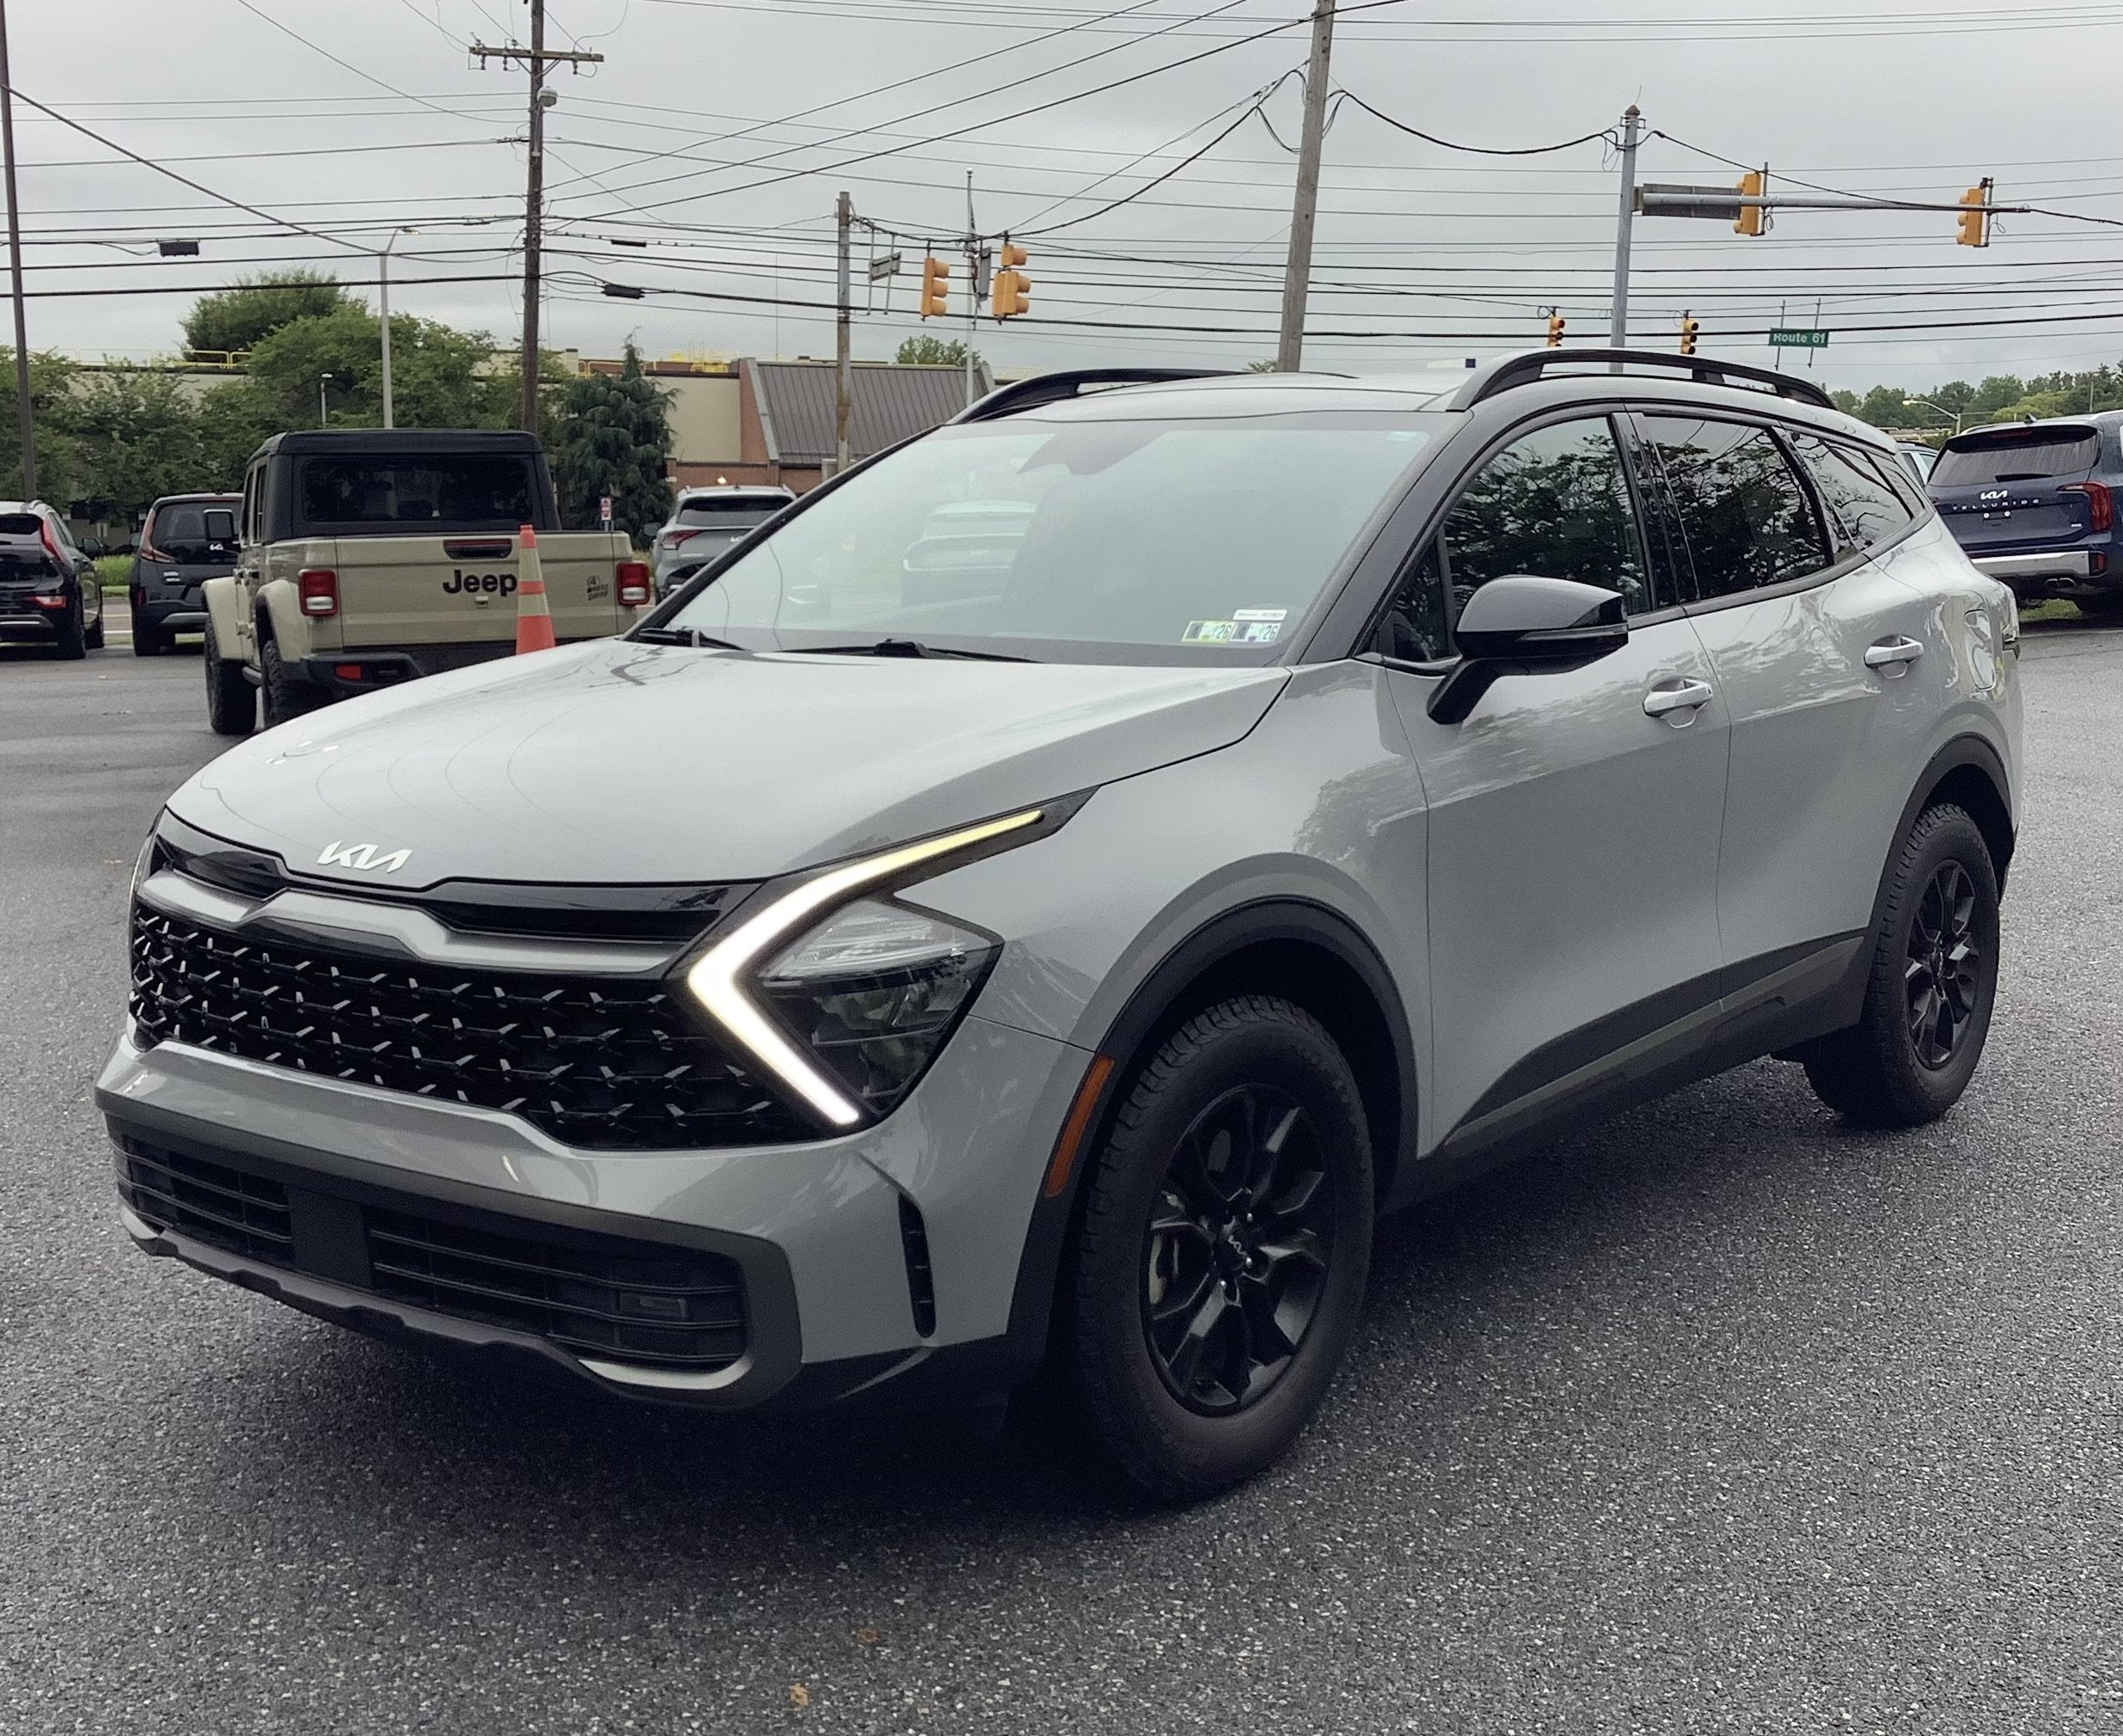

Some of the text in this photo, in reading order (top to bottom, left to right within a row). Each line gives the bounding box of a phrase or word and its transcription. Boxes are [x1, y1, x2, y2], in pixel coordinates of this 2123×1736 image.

[1772, 333, 1826, 344] Route 61
[443, 569, 517, 596] Jeep
[1216, 624, 1233, 639] 26
[1263, 625, 1278, 640] 26
[316, 840, 413, 874] KIA
